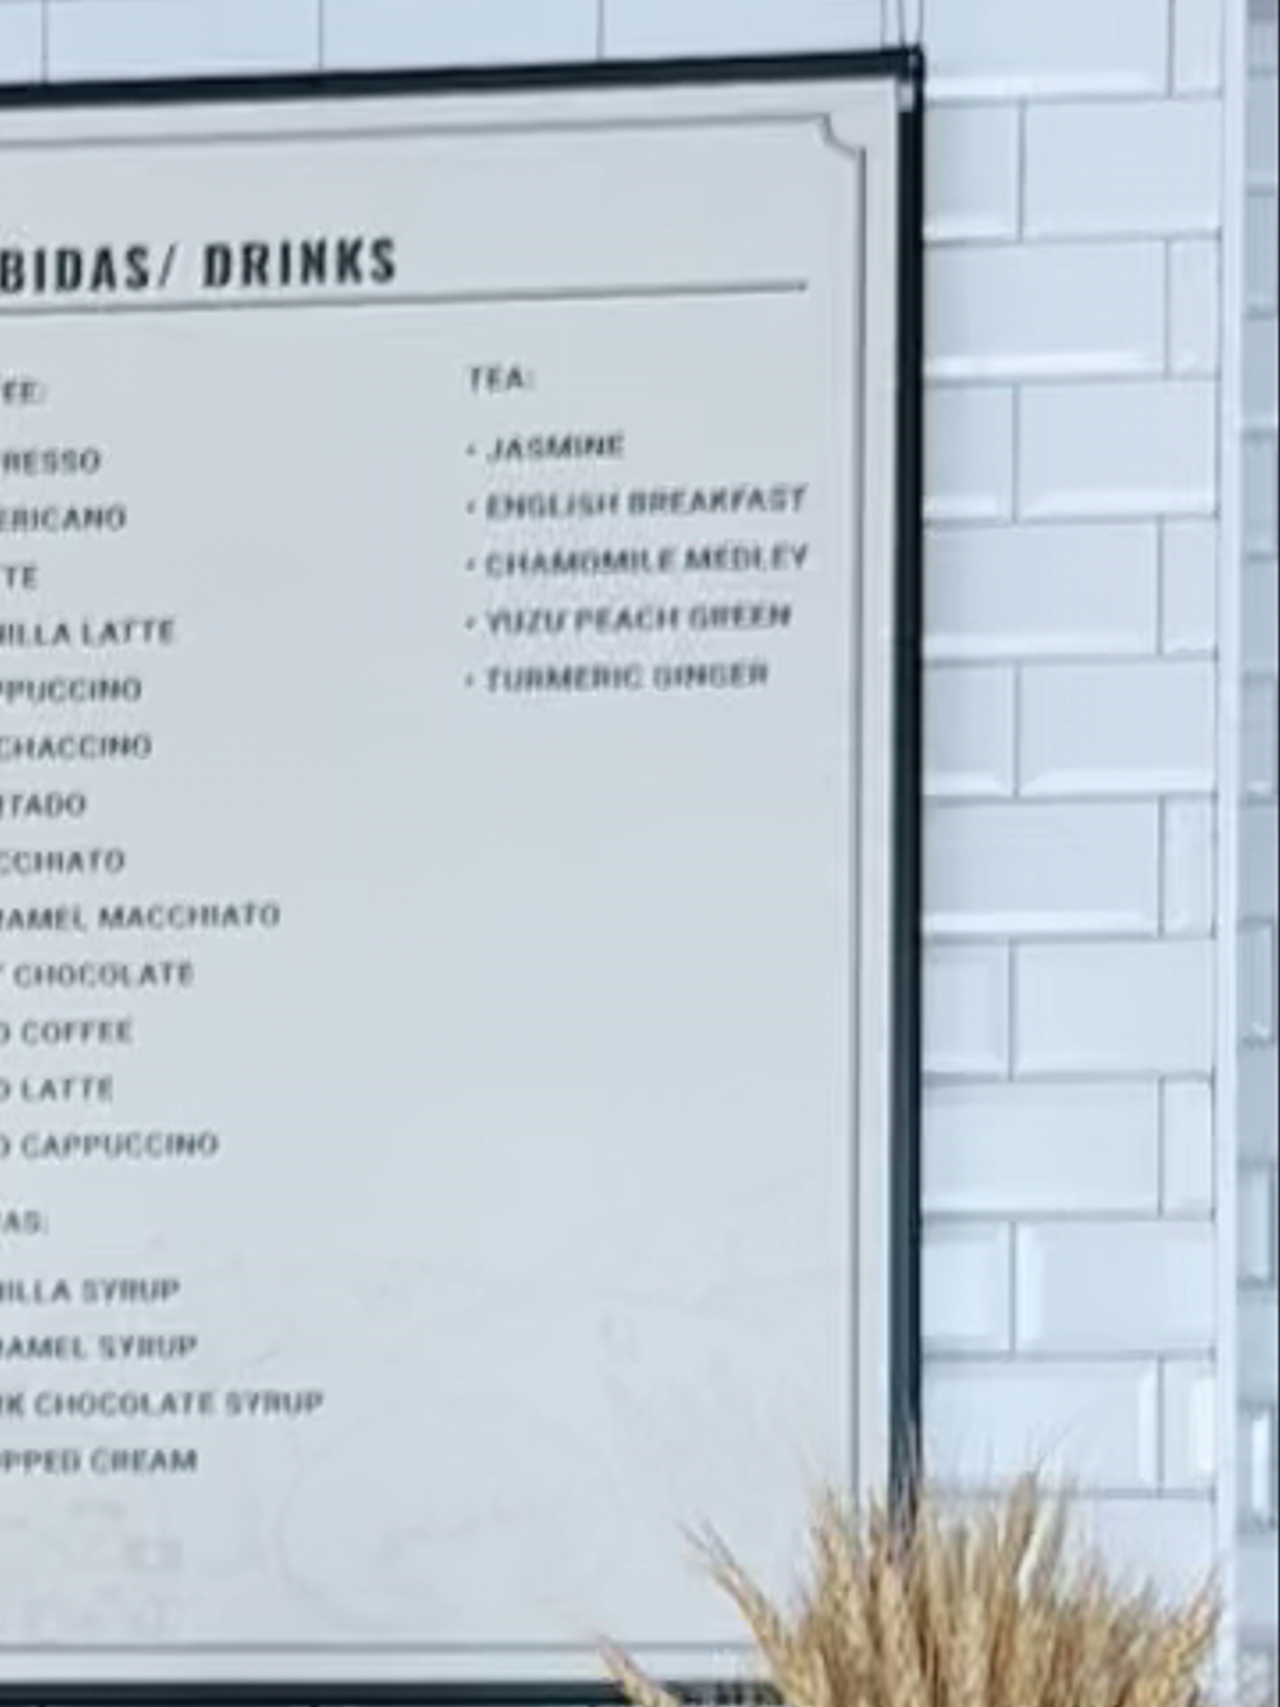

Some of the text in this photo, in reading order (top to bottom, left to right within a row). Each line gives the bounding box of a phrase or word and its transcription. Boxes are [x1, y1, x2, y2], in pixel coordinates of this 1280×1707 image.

[202, 236, 396, 288] DRINKS
[486, 433, 625, 463] JASMINE
[485, 482, 809, 521] ENGLISH BREAKFAST
[484, 542, 809, 580] CHAMOMILE MEDLEY
[80, 617, 176, 647] LATTE
[484, 601, 793, 636] YUZU PEACH GREEN
[486, 660, 770, 694] TURMERIC GINGER
[97, 900, 282, 931] MACCHIATO
[12, 959, 195, 990] CHOCOLATE
[20, 1017, 133, 1047] COFFEE
[19, 1074, 114, 1103] LATTE
[19, 1129, 221, 1160] CAPPUCCINO
[81, 1277, 182, 1306] SYRUP
[97, 1334, 199, 1361] SYRUP
[33, 1389, 215, 1419] CHOCOLATE
[224, 1389, 325, 1417] SYRUP
[89, 1446, 199, 1475] CREAM
